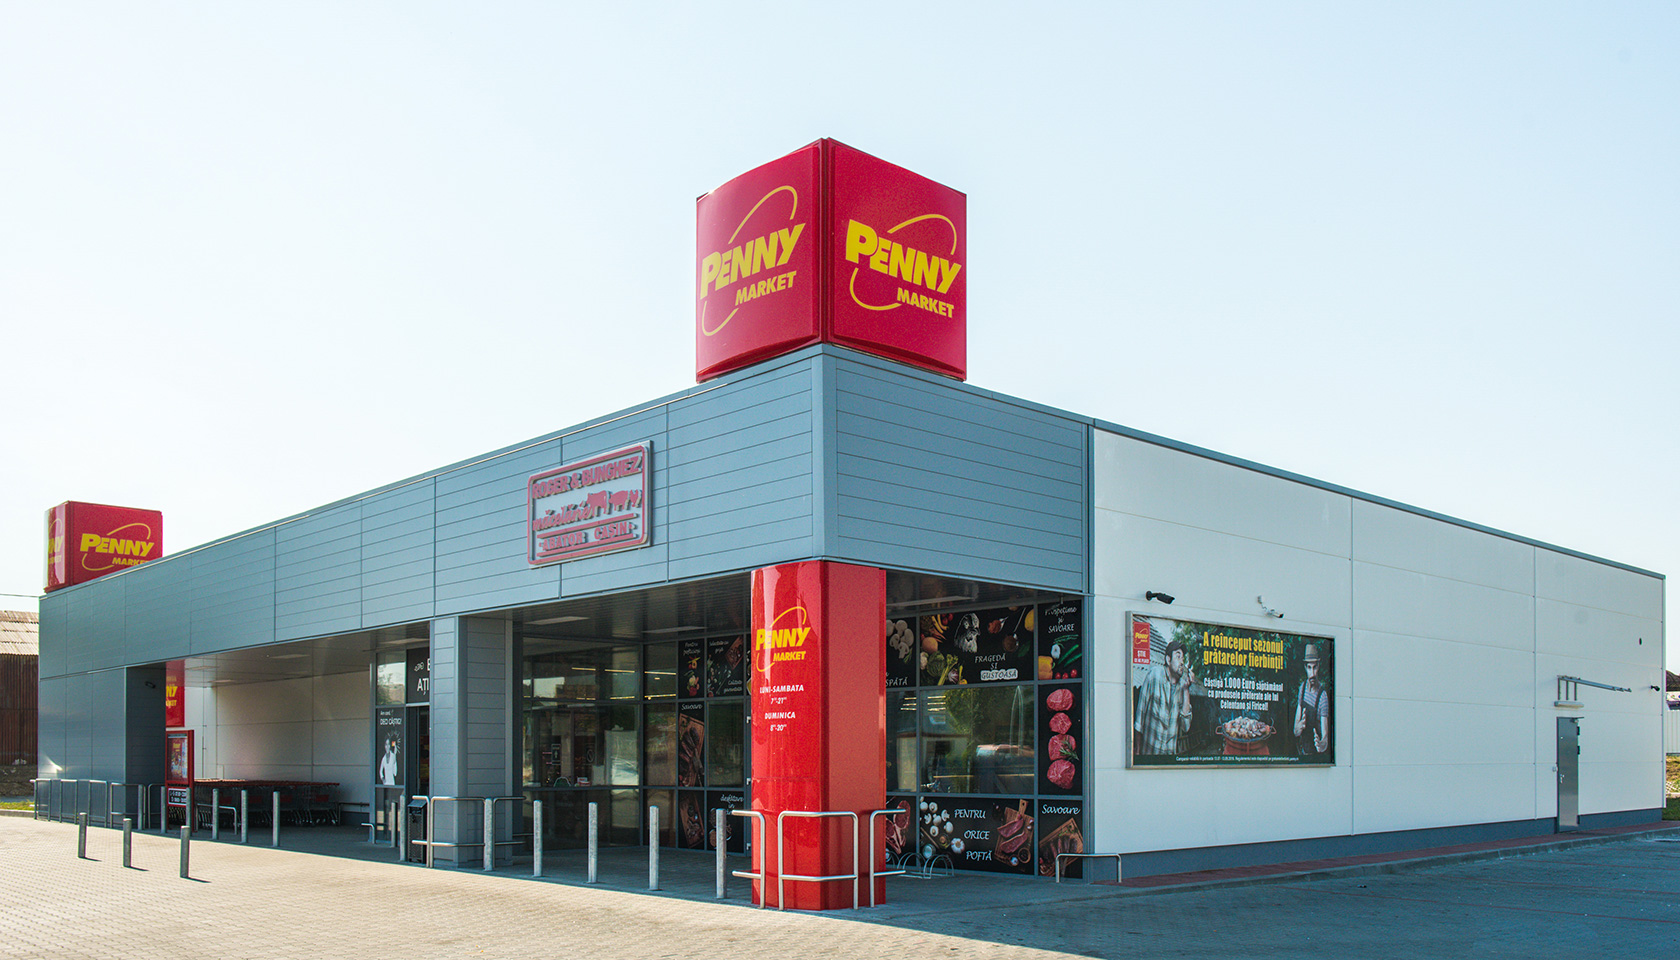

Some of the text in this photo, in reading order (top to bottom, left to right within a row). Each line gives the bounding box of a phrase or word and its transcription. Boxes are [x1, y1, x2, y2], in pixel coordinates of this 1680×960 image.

[700, 222, 806, 300] PENNY
[845, 218, 962, 294] PENNY
[735, 270, 797, 306] MARKET
[897, 287, 955, 318] MARKET
[532, 455, 641, 499] ROGER & BUNGHEZ
[80, 533, 155, 557] PENNY
[542, 532, 584, 551] ABATOR
[755, 627, 811, 651] PENNY
[1048, 623, 1075, 634] SAVOARE
[1203, 631, 1284, 654] A reînceput sezonul
[773, 651, 806, 662] MARKET
[1203, 648, 1247, 666] grătarelor
[1224, 677, 1241, 689] 1.000
[1241, 678, 1255, 690] Euro
[954, 809, 986, 819] PENTRU
[1041, 803, 1080, 815] Savoare
[964, 830, 990, 840] ORICE
